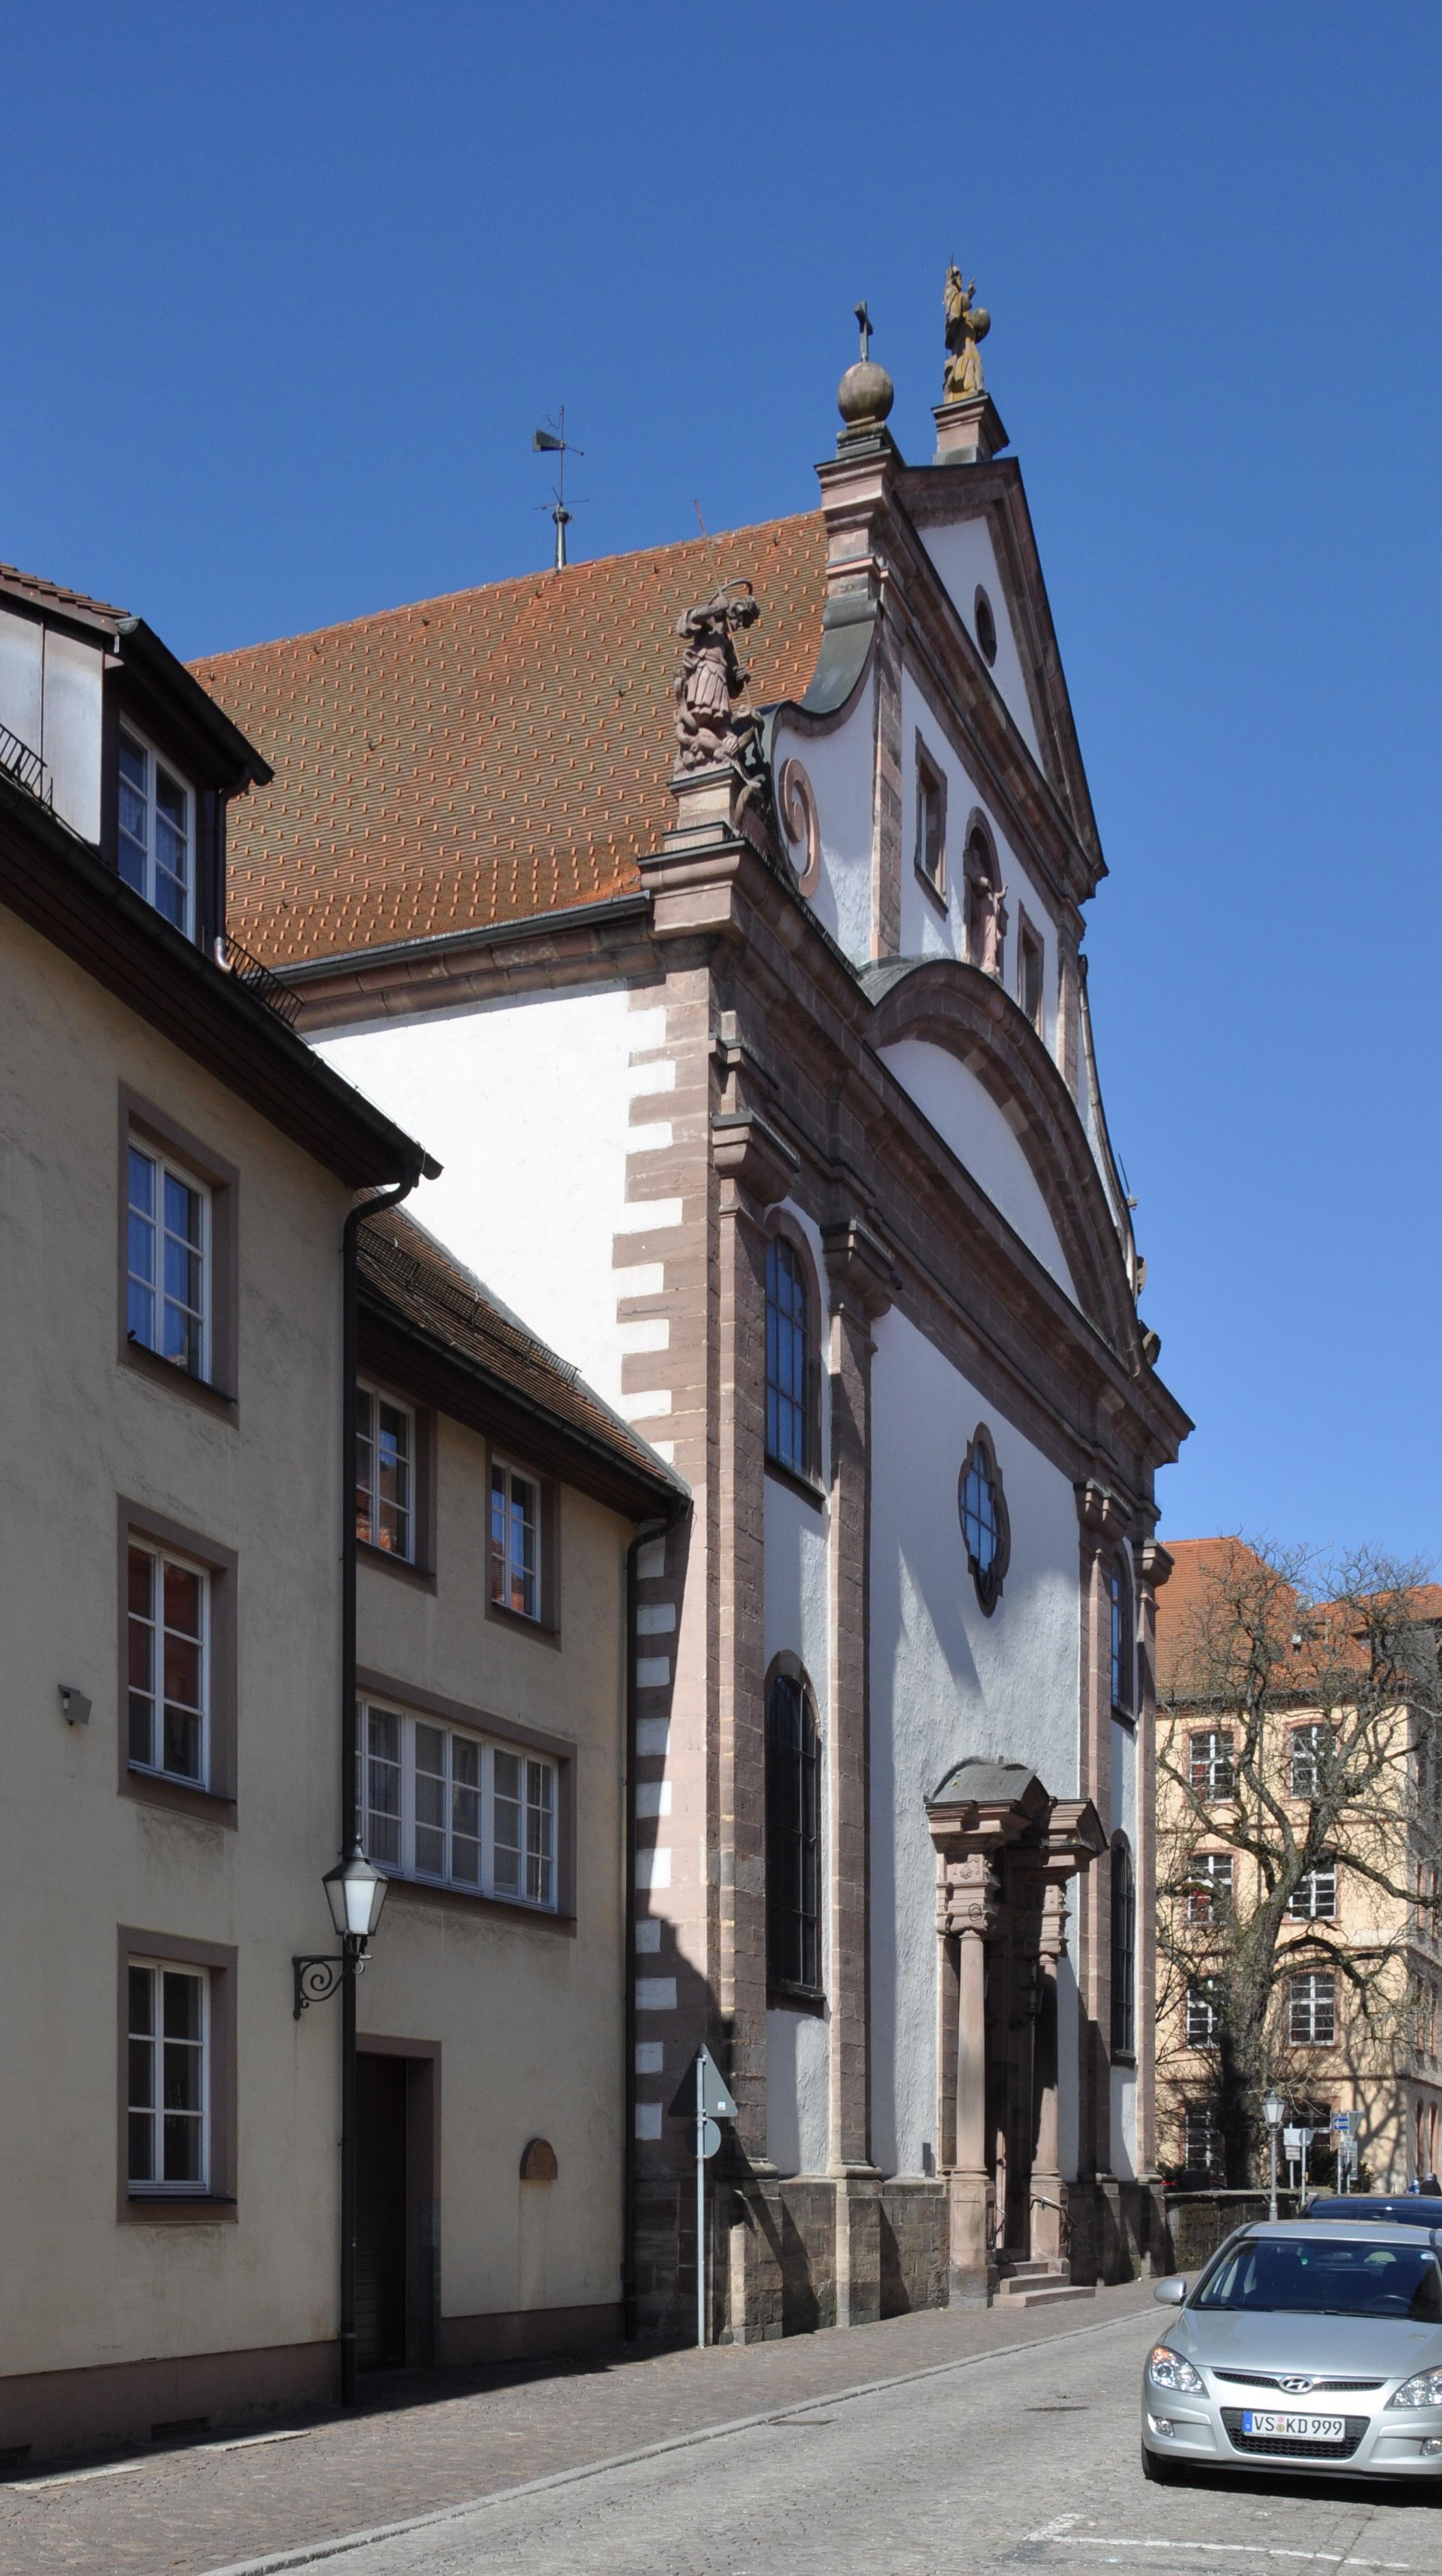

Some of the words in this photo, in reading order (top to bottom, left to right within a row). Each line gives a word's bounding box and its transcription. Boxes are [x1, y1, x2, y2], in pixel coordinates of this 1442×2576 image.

[1254, 2415, 1275, 2431] VS
[1286, 2417, 1308, 2434] KD
[1311, 2420, 1342, 2435] 999
